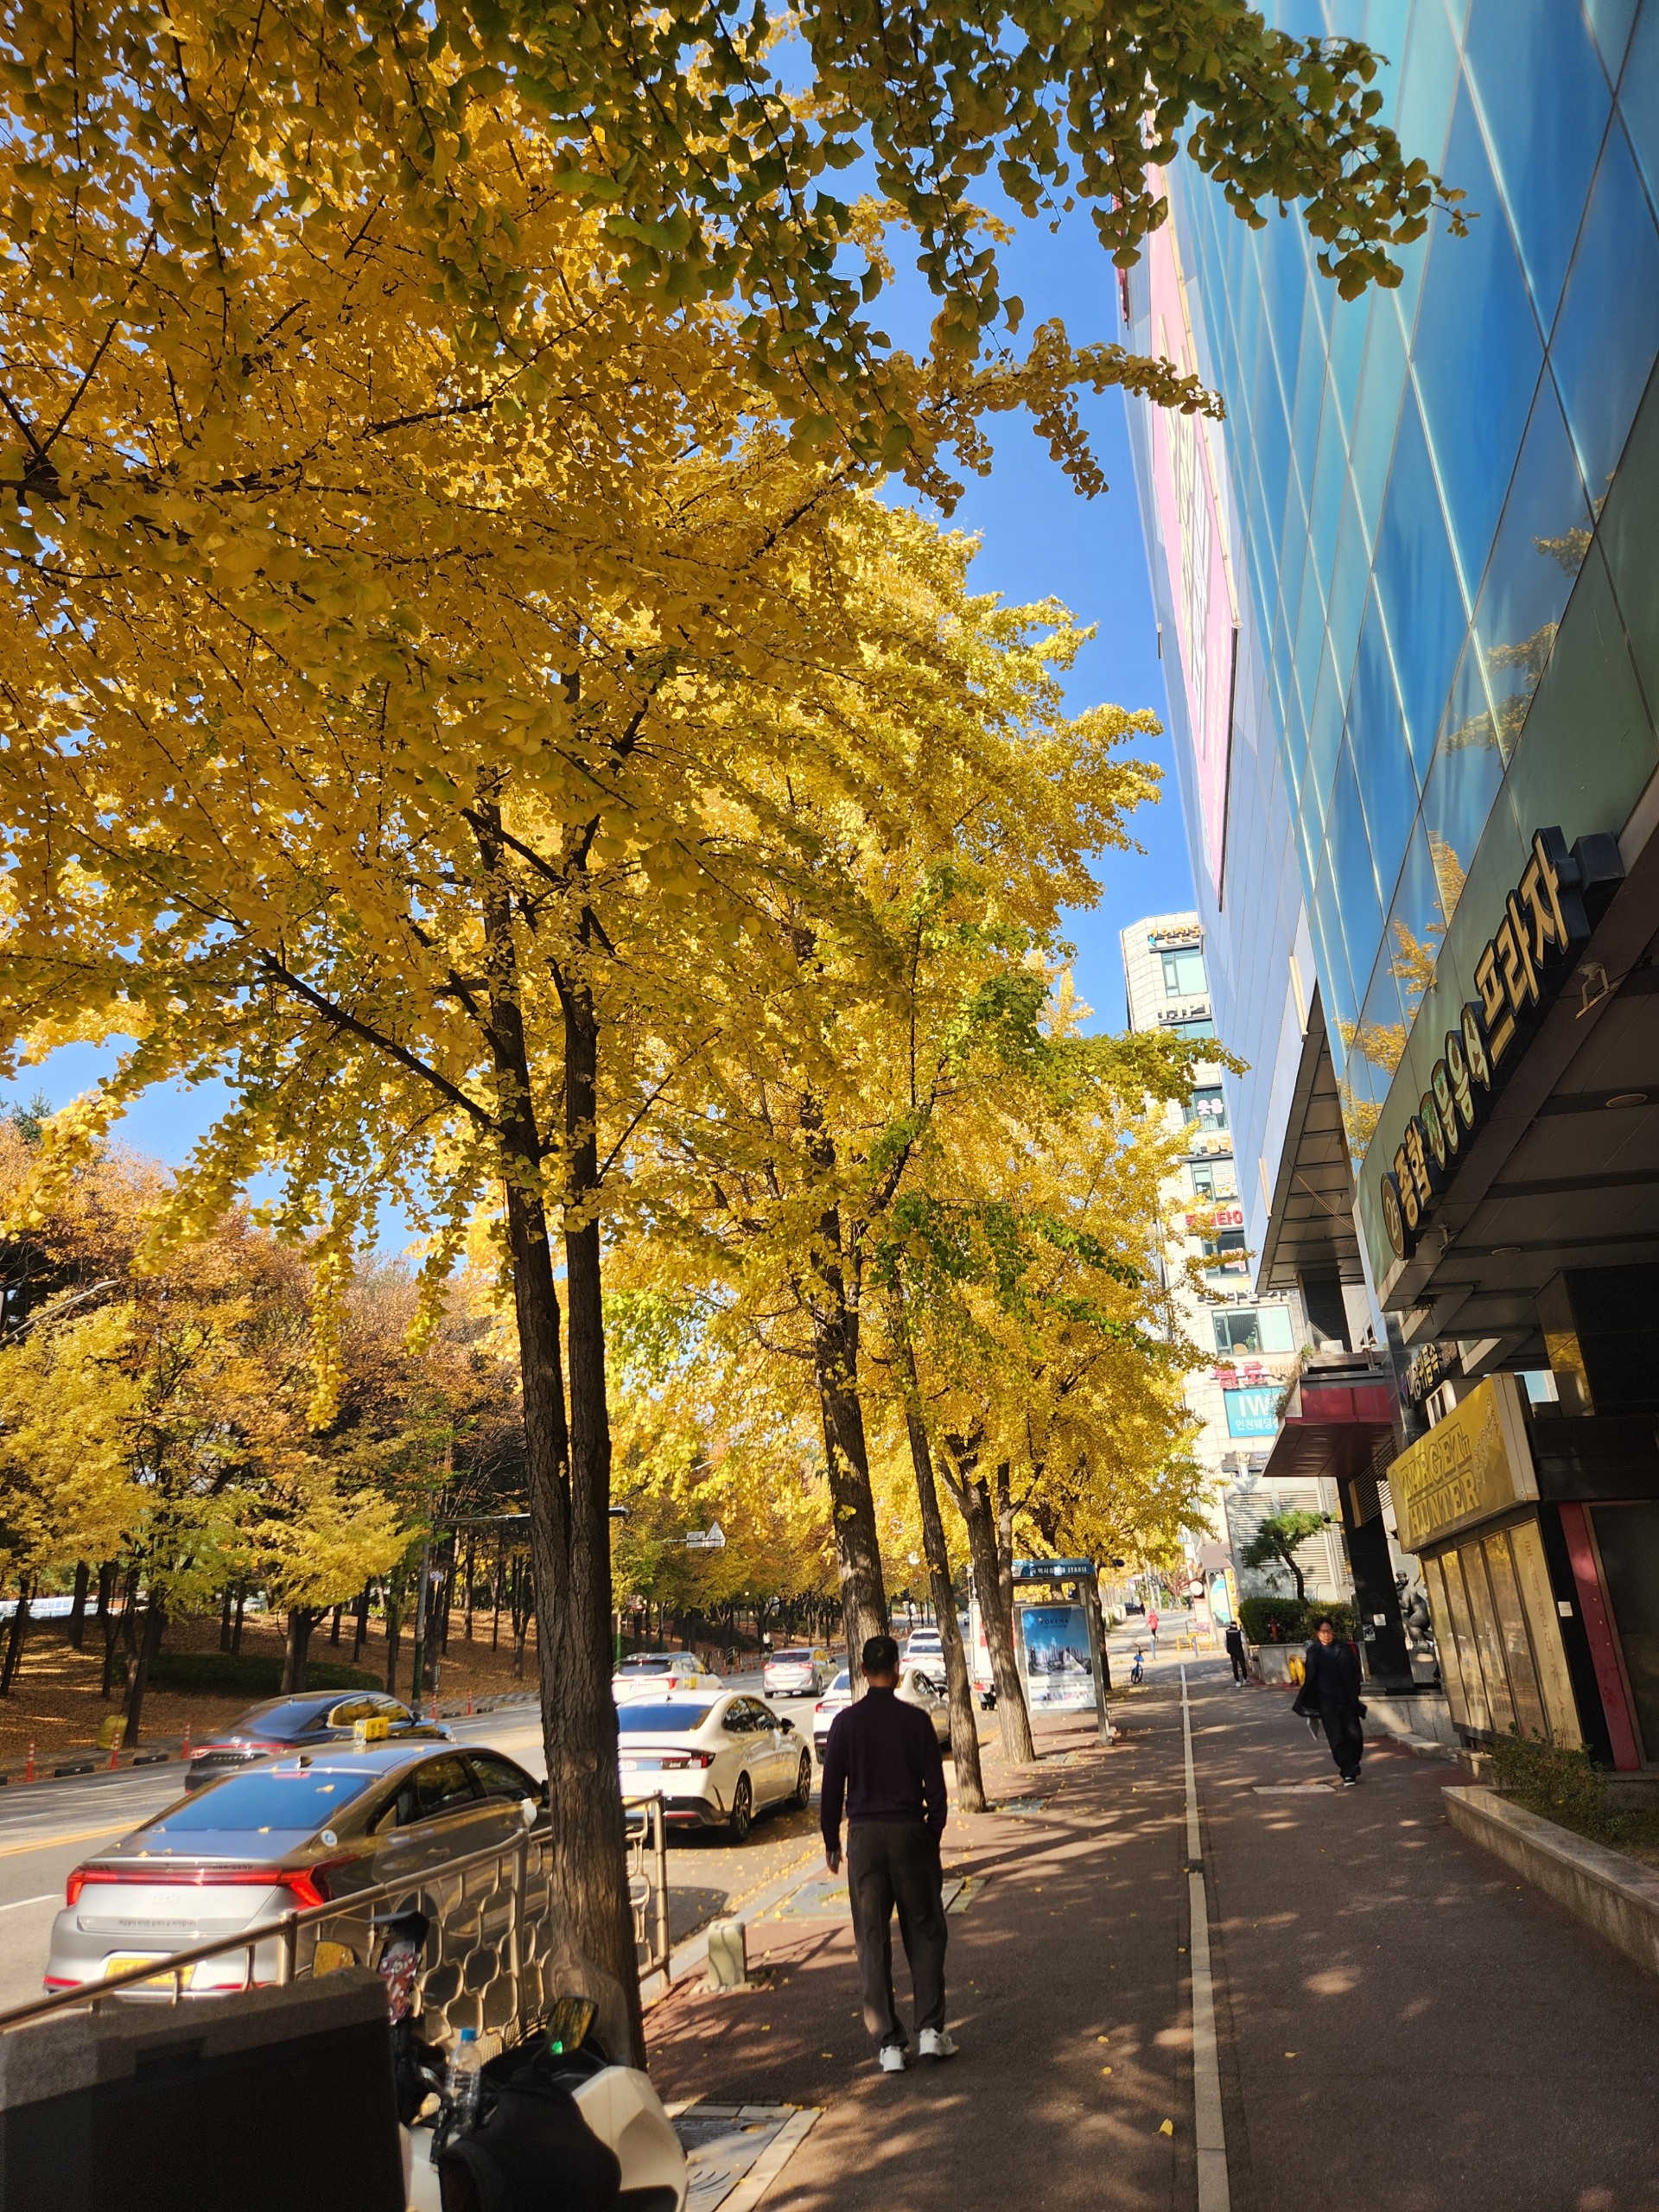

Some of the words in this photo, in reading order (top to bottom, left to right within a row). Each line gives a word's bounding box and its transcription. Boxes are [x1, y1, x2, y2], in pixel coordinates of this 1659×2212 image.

[1395, 1121, 1433, 1230] 종합
[1476, 834, 1569, 1069] 프라자
[1400, 1423, 1466, 1497] TARGET
[1408, 1471, 1481, 1538] HUNTER
